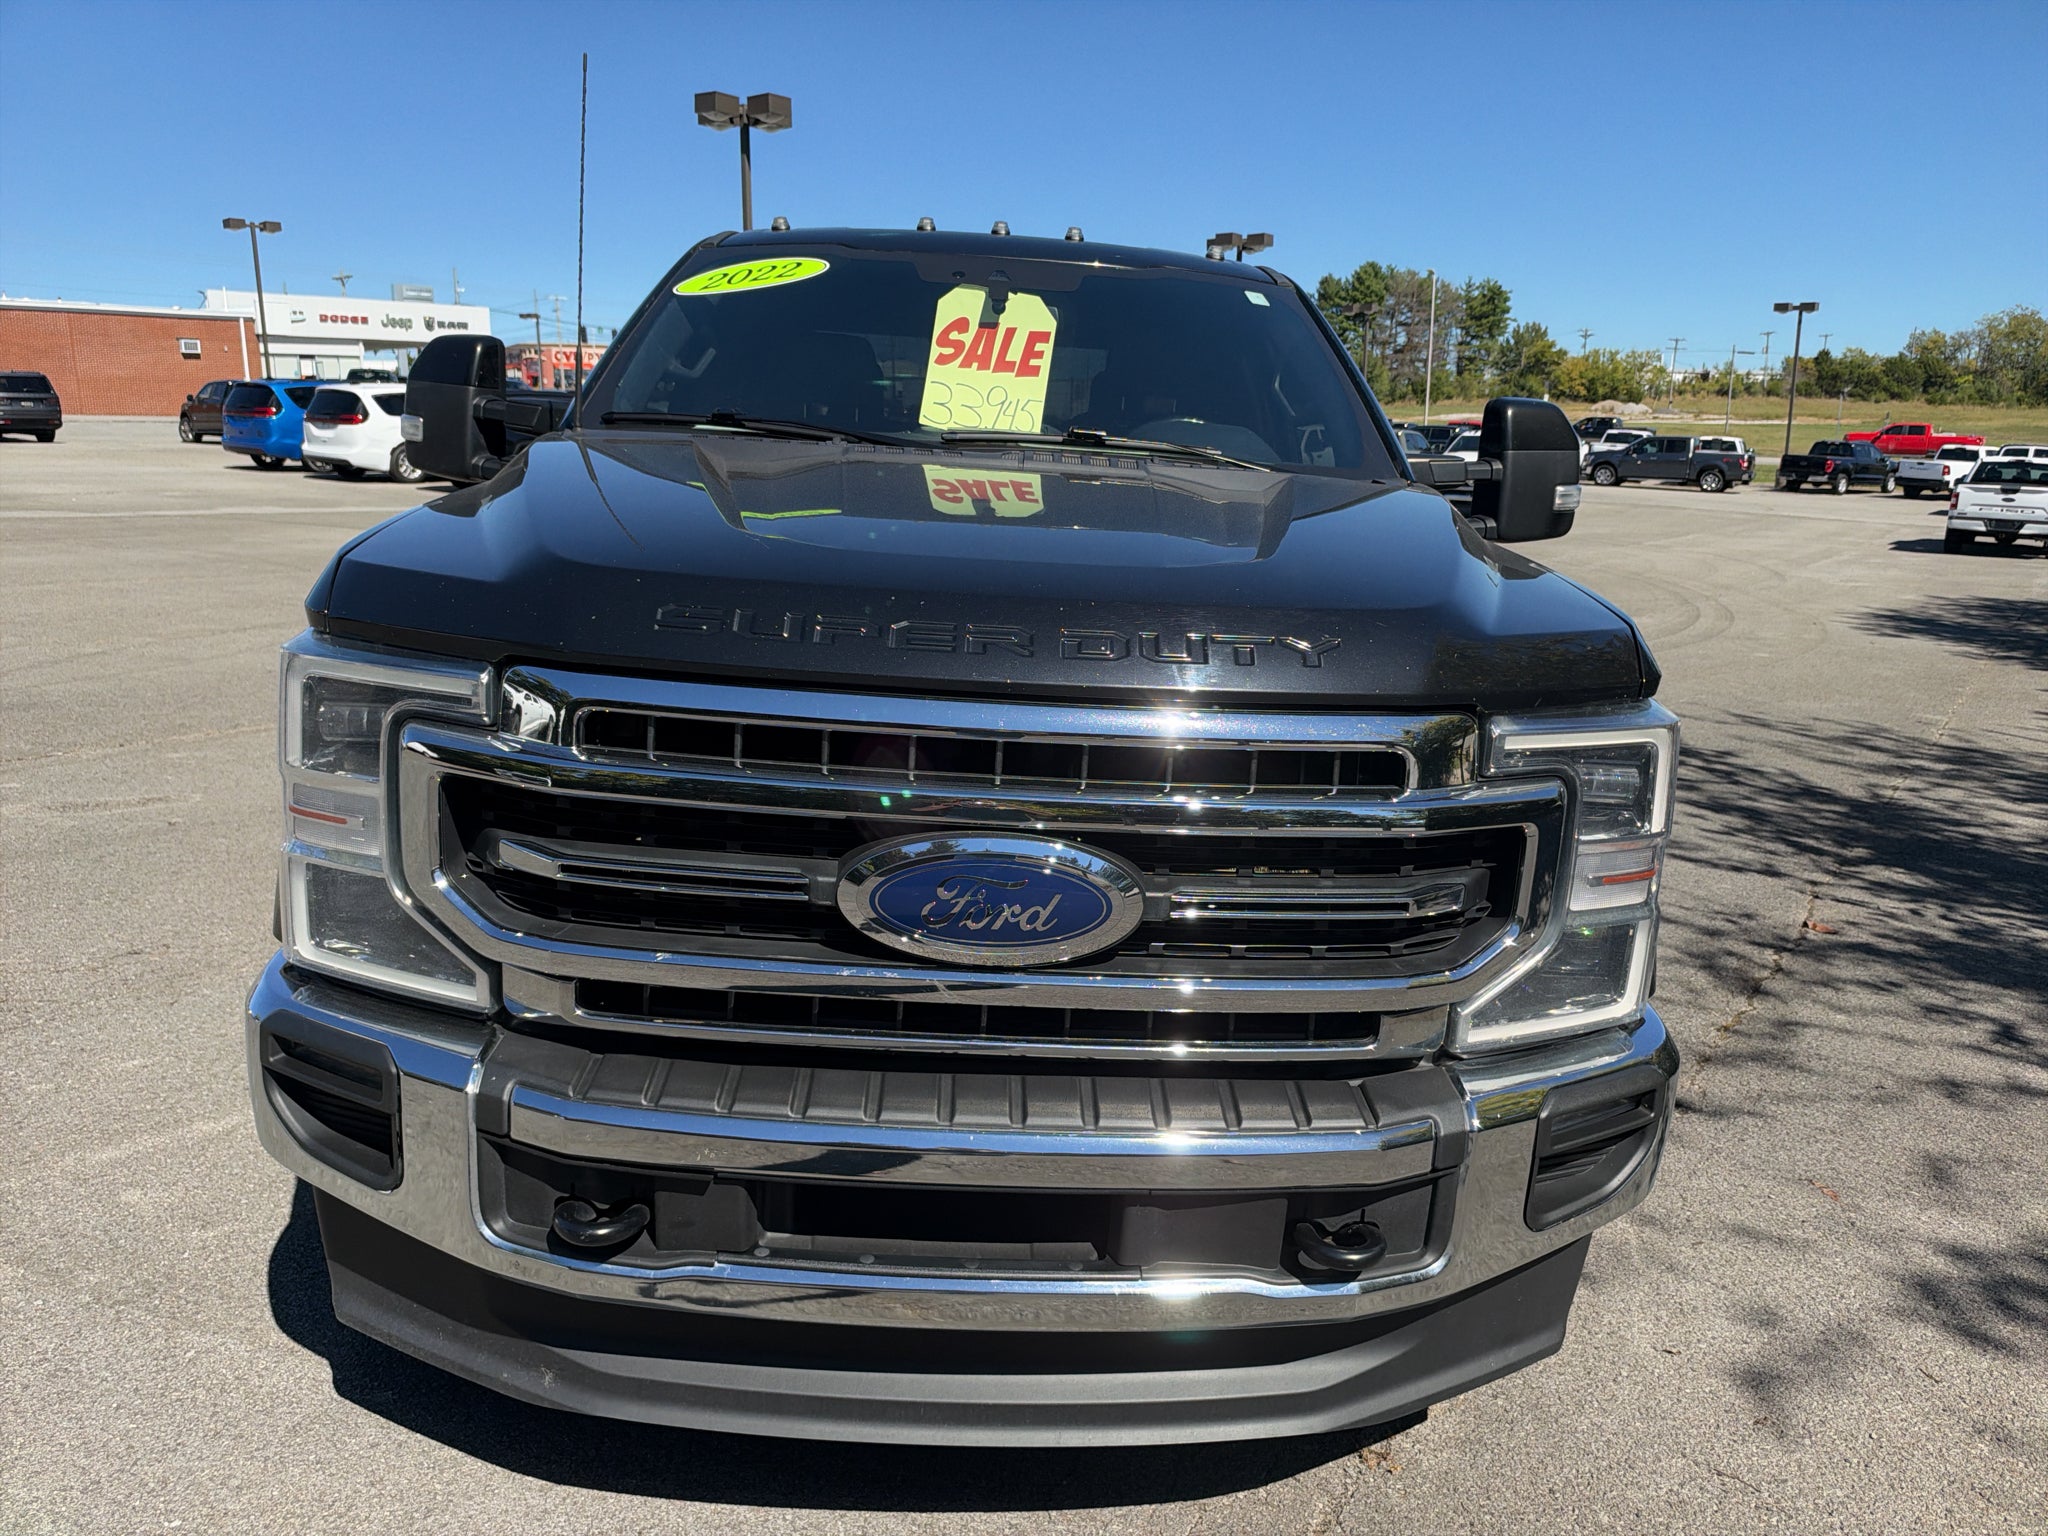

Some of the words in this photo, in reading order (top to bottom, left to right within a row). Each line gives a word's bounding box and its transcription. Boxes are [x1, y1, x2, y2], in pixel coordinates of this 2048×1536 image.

[698, 261, 803, 291] 2022
[319, 313, 369, 325] DODGE
[381, 313, 413, 331] Jeep
[436, 319, 469, 331] RAM
[933, 316, 1052, 378] SALE
[653, 603, 1035, 657] SUPER
[1060, 627, 1342, 668] DUTY
[919, 873, 1063, 933] Ford
